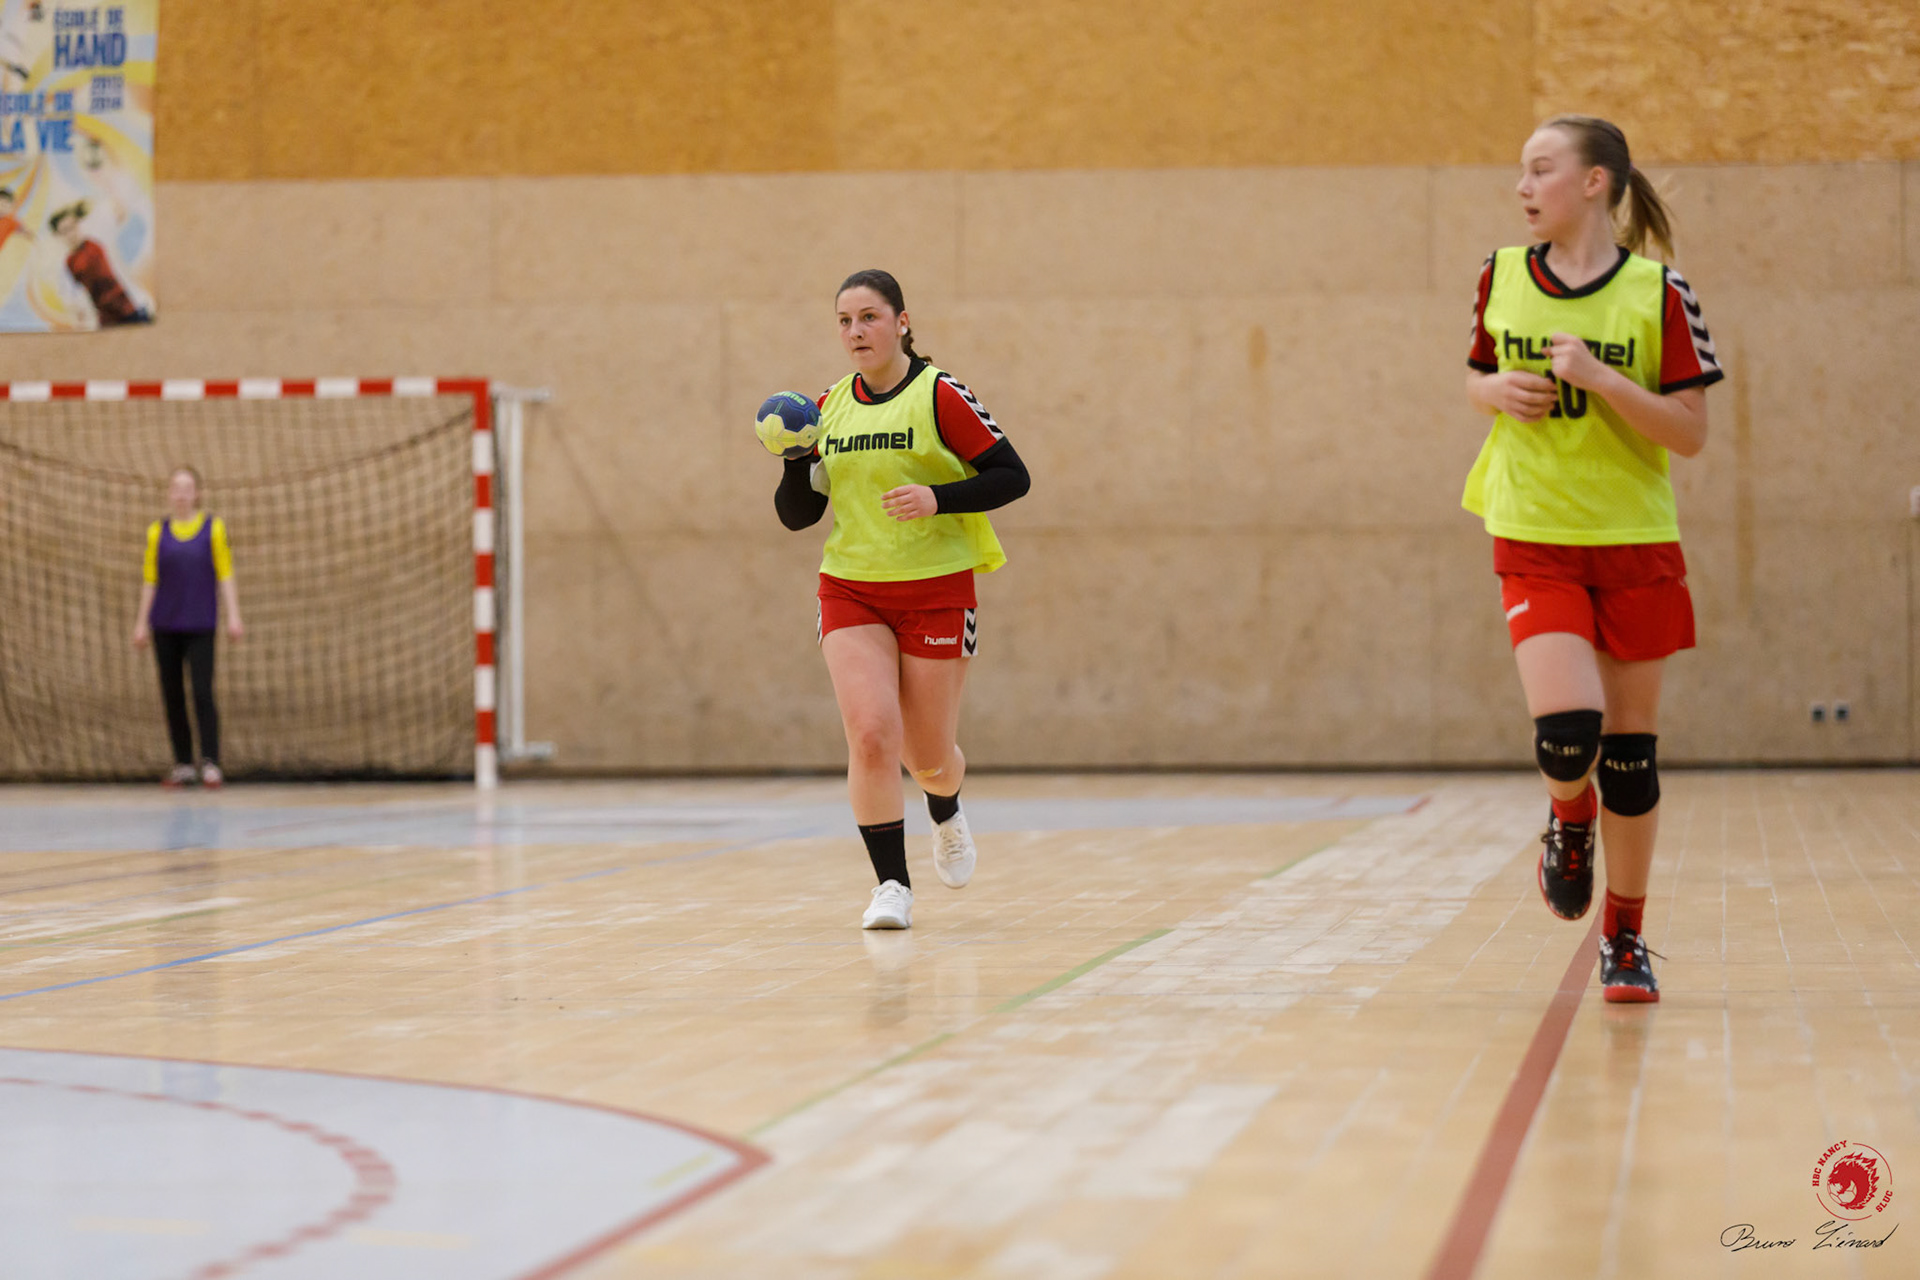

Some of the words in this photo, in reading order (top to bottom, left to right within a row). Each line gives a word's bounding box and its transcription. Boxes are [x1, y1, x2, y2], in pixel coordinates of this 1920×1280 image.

[54, 33, 126, 67] HAND
[36, 119, 73, 152] VIE
[825, 427, 913, 456] hummel
[924, 635, 958, 645] hummel
